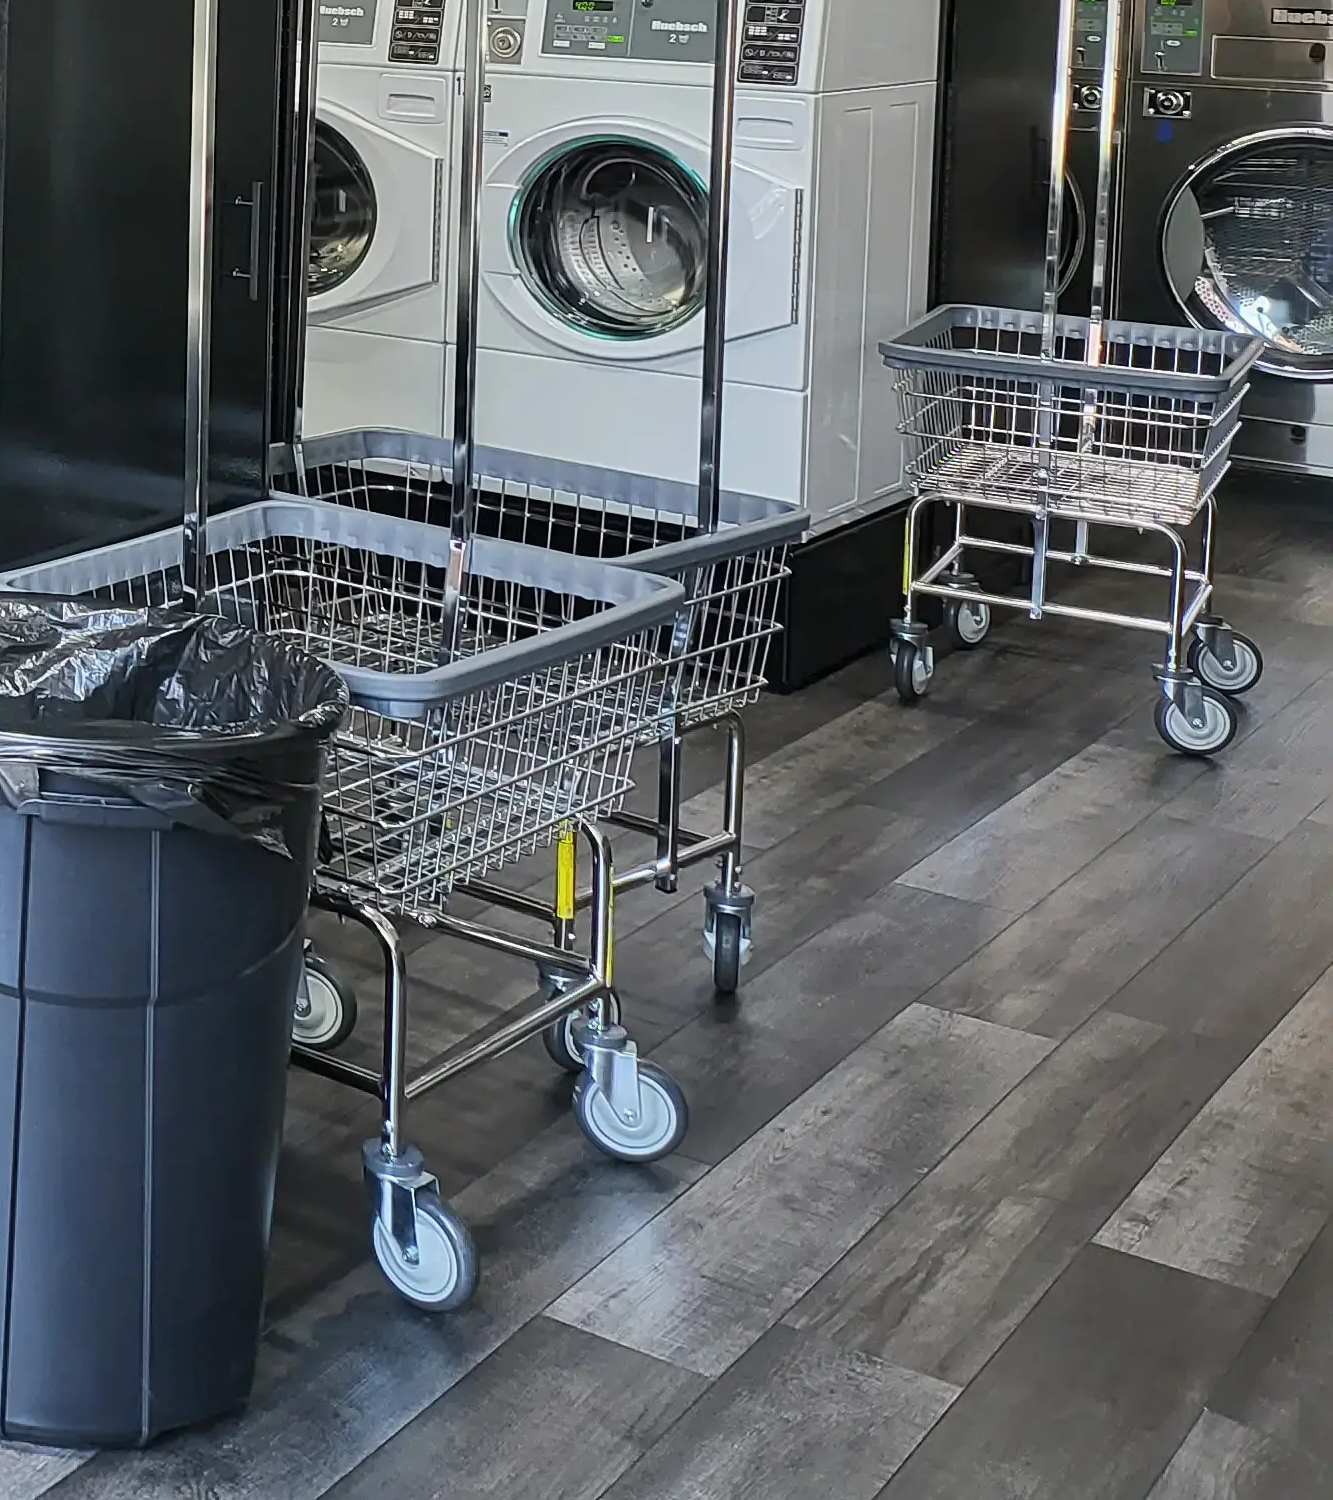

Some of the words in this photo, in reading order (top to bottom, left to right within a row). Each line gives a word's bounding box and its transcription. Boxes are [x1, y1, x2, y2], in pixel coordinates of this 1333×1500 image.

[331, 18, 338, 26] 2
[651, 20, 708, 33] Huebsch
[668, 34, 677, 44] 2
